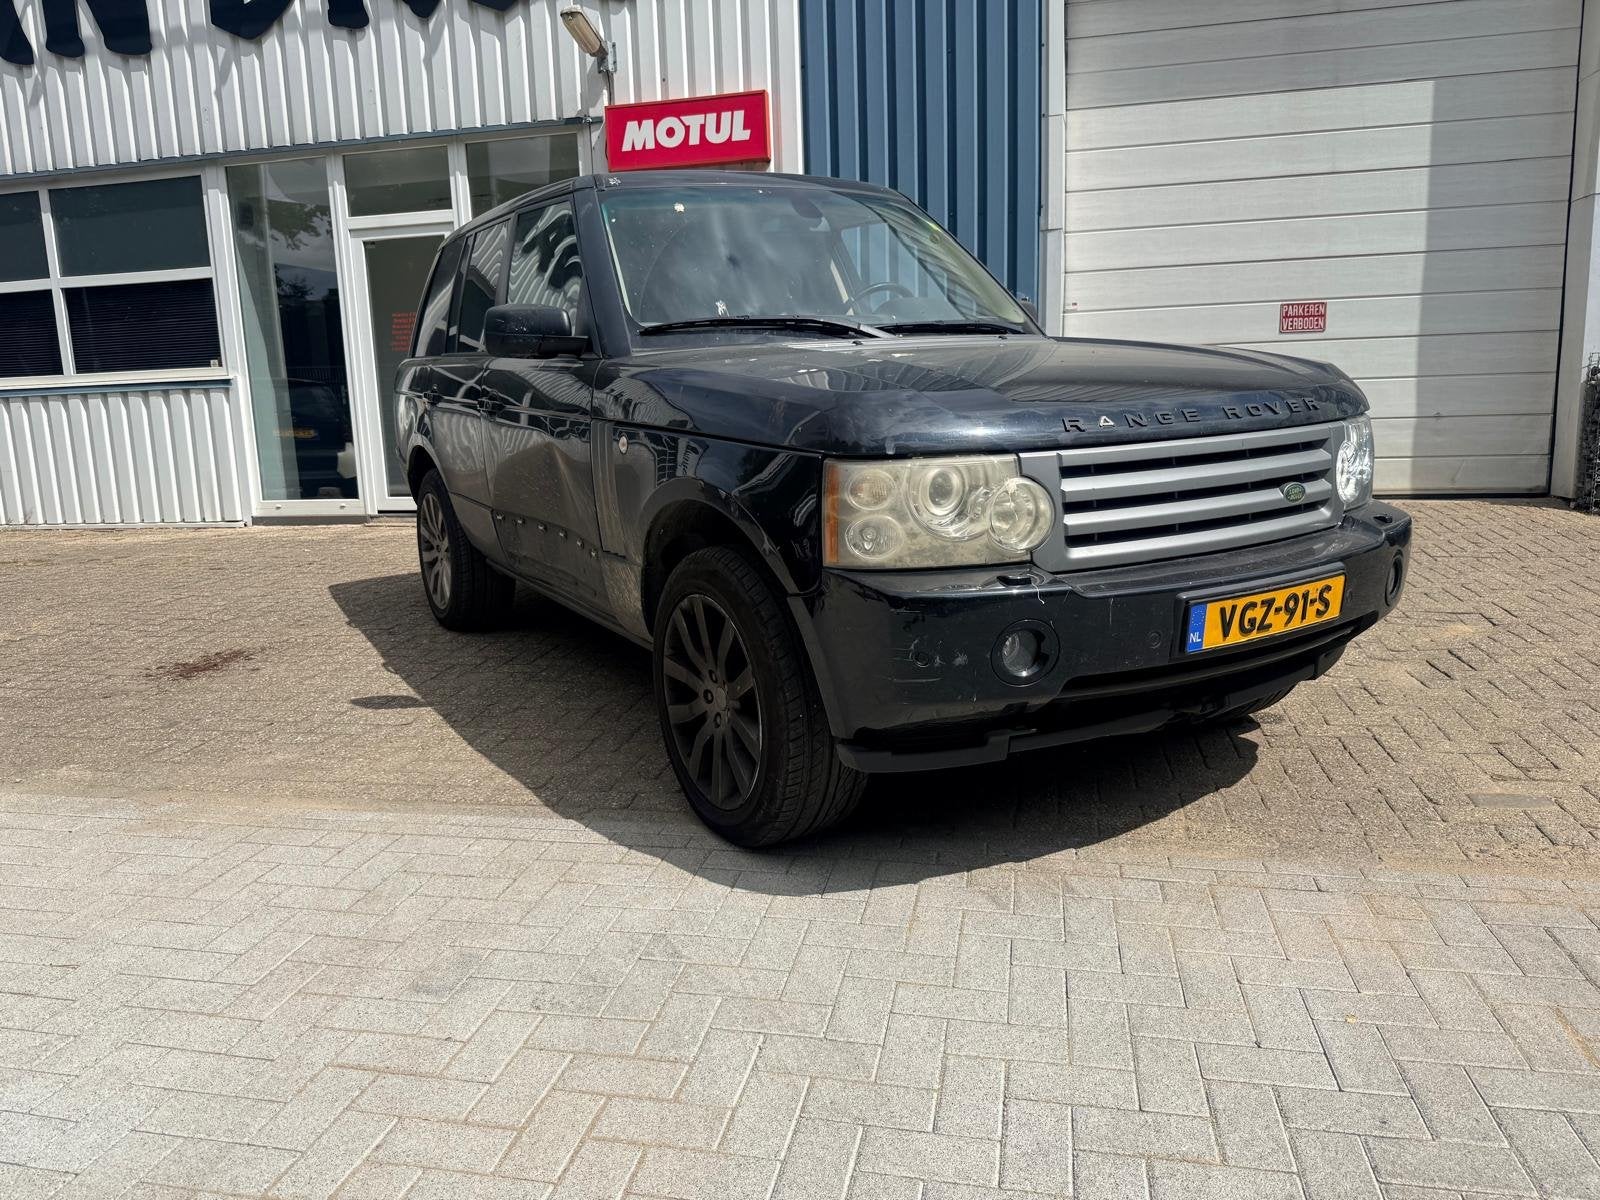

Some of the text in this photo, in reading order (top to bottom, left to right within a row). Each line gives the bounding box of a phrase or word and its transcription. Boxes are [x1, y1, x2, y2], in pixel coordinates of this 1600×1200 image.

[621, 109, 751, 152] MOTUL
[1282, 304, 1325, 317] PARKEREN
[1282, 317, 1324, 330] VERBODEN
[1062, 398, 1321, 433] RANGE ROVER
[1219, 584, 1332, 641] VGZ-91-S
[1189, 631, 1202, 643] NL
